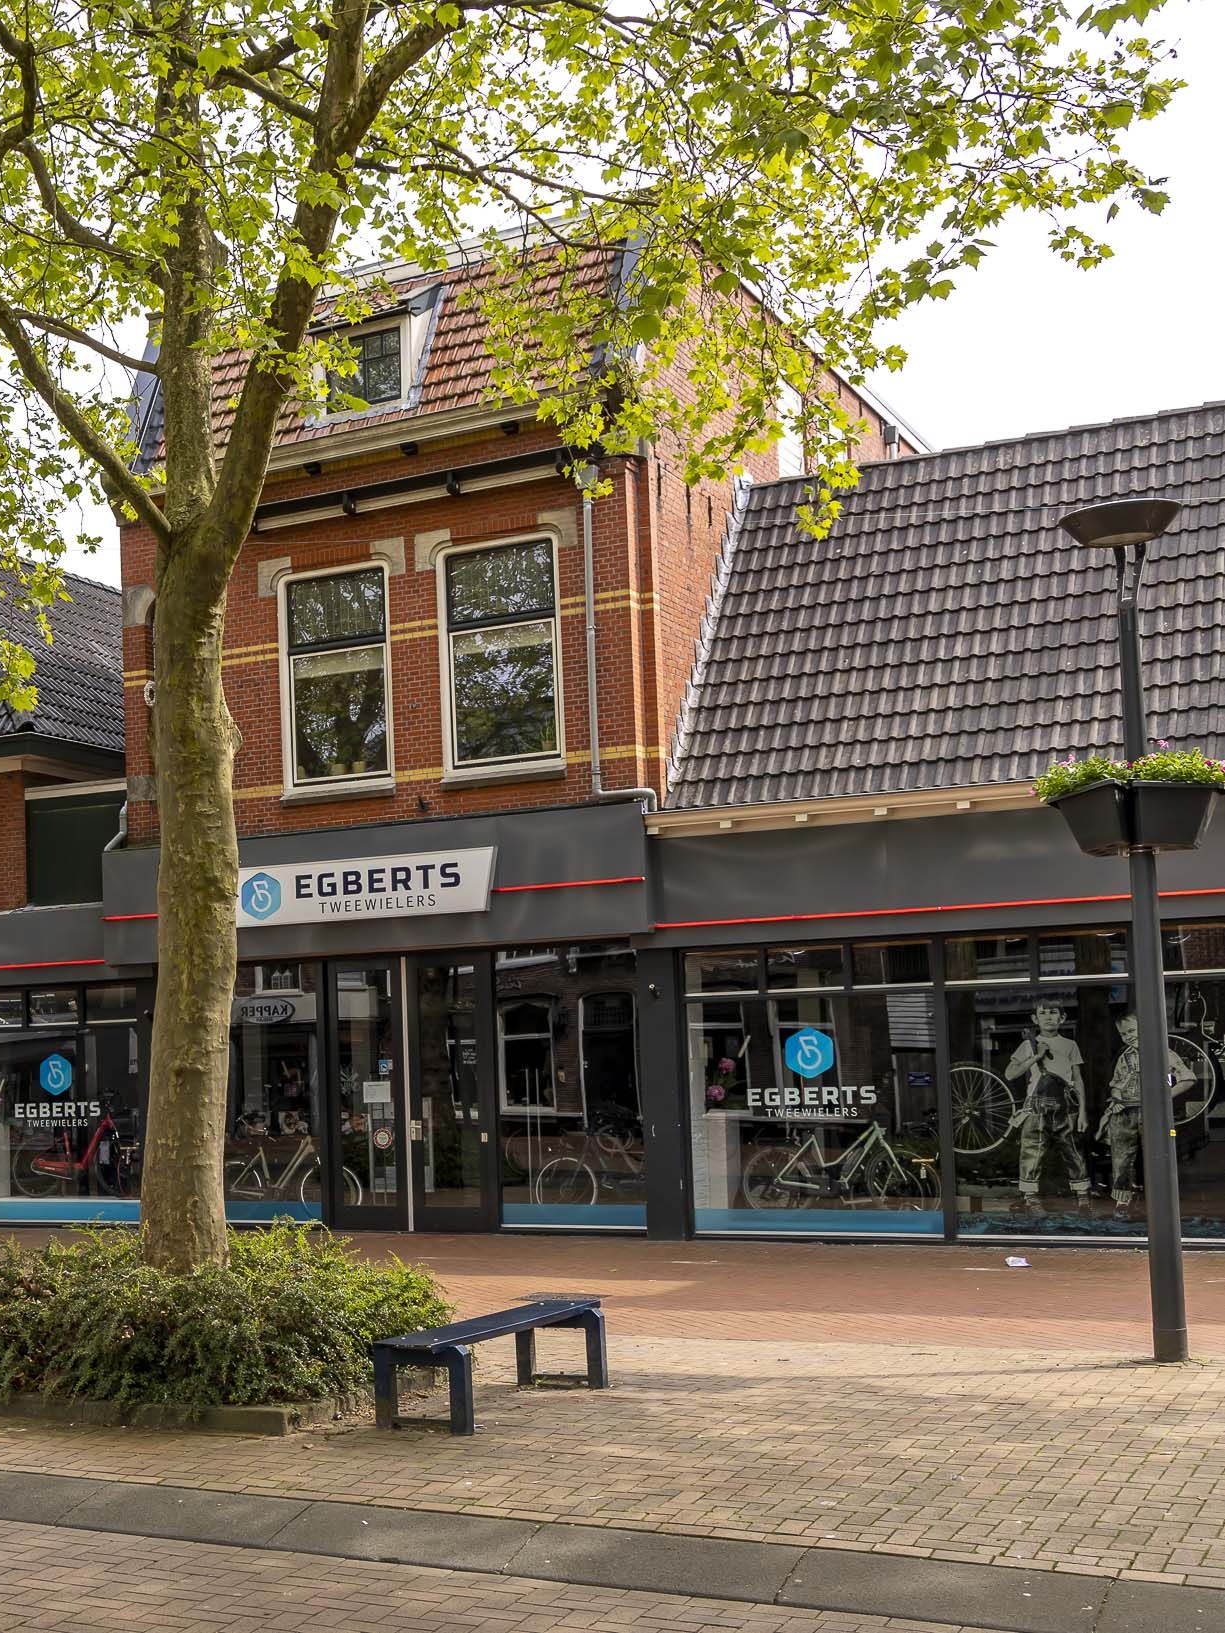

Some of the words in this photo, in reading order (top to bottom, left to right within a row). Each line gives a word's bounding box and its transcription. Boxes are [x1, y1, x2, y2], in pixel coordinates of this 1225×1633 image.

[295, 862, 461, 899] EGBERTS
[319, 894, 436, 914] TWEEWIELERS
[747, 1085, 876, 1106] EGBERTS
[14, 1101, 101, 1118] EGBERTS
[765, 1107, 858, 1118] TWEEWIELERS
[27, 1118, 89, 1128] TWEEWIELERS
